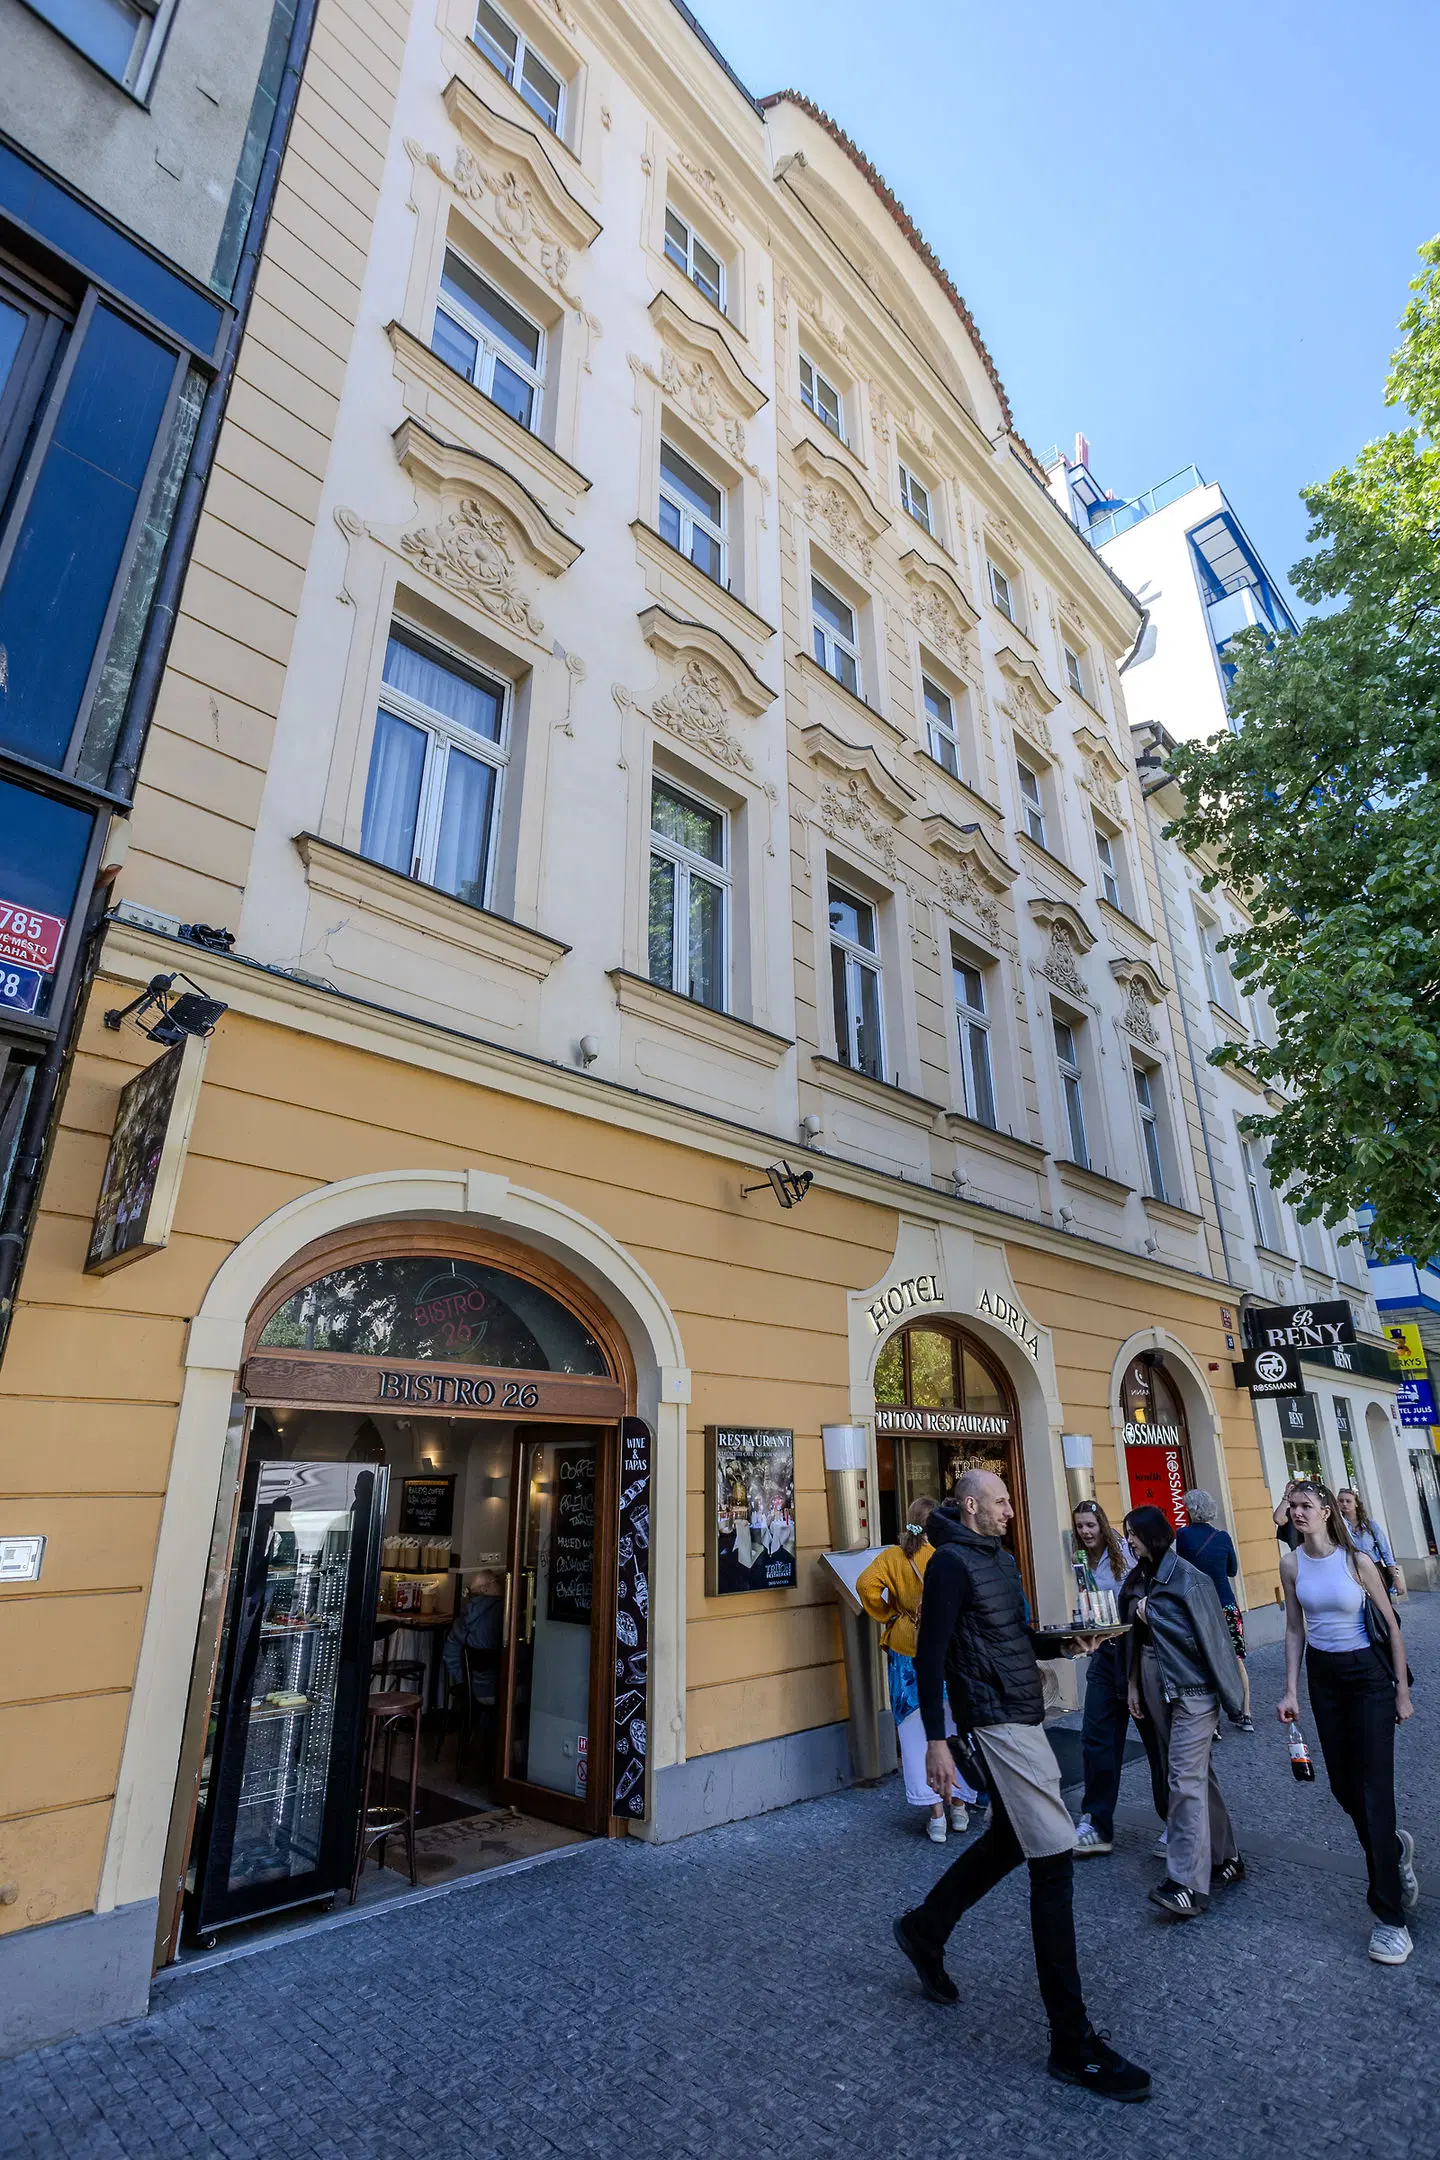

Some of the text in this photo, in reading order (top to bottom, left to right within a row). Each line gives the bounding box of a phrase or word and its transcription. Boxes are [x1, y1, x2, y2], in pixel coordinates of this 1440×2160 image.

[0, 906, 43, 939] 785
[11, 937, 48, 955] MĚSTO
[32, 953, 37, 962] 1
[414, 1290, 486, 1328] BISTRO
[866, 1275, 1040, 1361] HOTEL ADRIA
[441, 1317, 472, 1347] 26
[1265, 1322, 1345, 1347] BENY
[1332, 1349, 1353, 1370] BENY
[378, 1371, 540, 1409] BISTRO 26
[1253, 1382, 1297, 1392] ROSSMANN
[875, 1411, 1010, 1434] RITON RESTAURANT
[1288, 1411, 1305, 1426] BENY
[626, 1437, 646, 1449] WINE
[718, 1433, 792, 1448] RESTAURANT
[632, 1449, 639, 1459] &
[560, 1459, 597, 1479] COFFE
[624, 1459, 647, 1471] TAPAS
